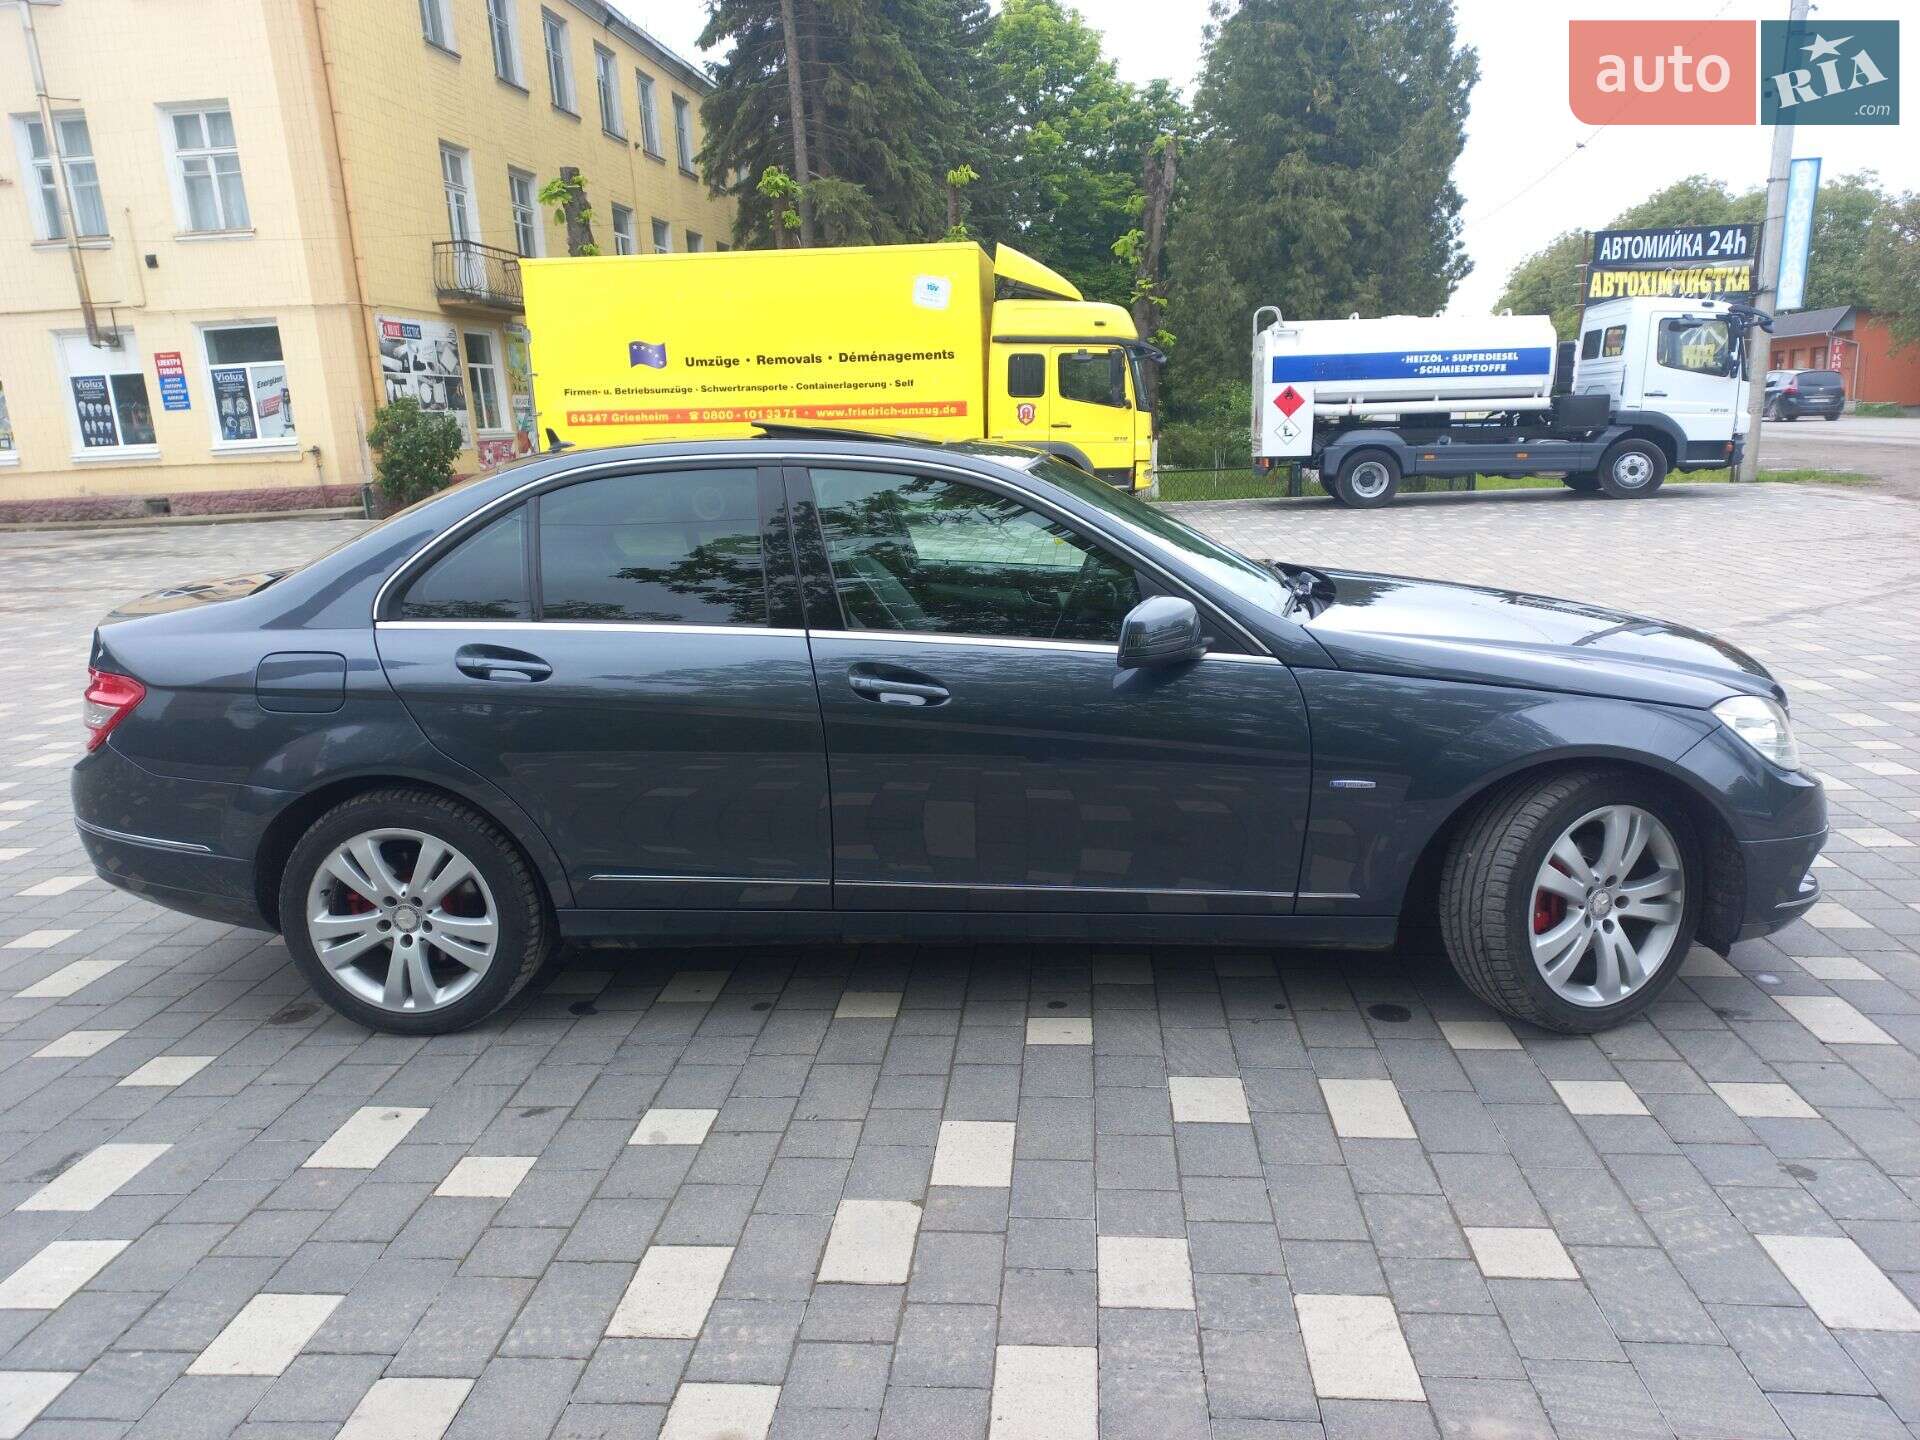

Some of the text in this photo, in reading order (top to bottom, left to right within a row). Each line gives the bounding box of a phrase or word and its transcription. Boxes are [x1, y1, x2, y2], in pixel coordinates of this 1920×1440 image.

[1599, 228, 1748, 261] АВТОМИЙКА 24h
[1588, 265, 1750, 298] АВТОХІМЧИСТКА
[685, 349, 955, 368] Umzüge Removals Déménagements
[1405, 351, 1519, 364] HEIZÖL SUPERDIESEL
[214, 372, 244, 382] Violux
[1419, 363, 1507, 374] SCHMIERSTOFFE
[564, 388, 601, 396] Firmen-
[614, 385, 693, 395] Betriebsumzüge
[700, 383, 788, 393] Schwertransporte
[796, 380, 887, 391] Containerlagerung
[894, 379, 914, 388] Self
[611, 411, 669, 423] Griesheim
[703, 410, 733, 420] 0800
[816, 405, 957, 417] www.friedrich-umzug.de
